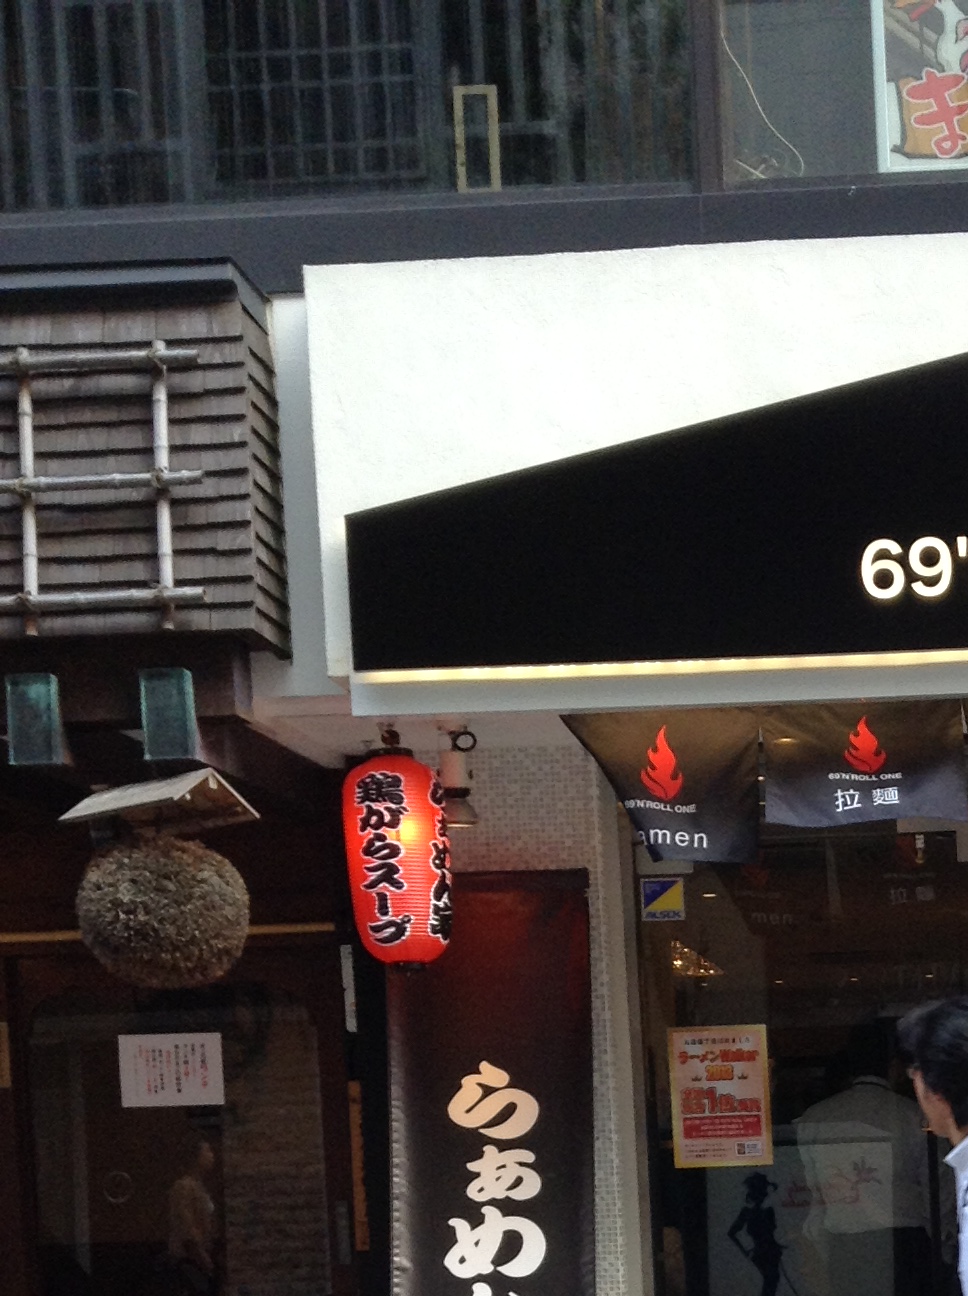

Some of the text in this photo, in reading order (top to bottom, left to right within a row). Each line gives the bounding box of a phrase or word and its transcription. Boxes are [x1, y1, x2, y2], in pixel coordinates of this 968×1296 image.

[355, 771, 414, 946] 鶏がらスープ
